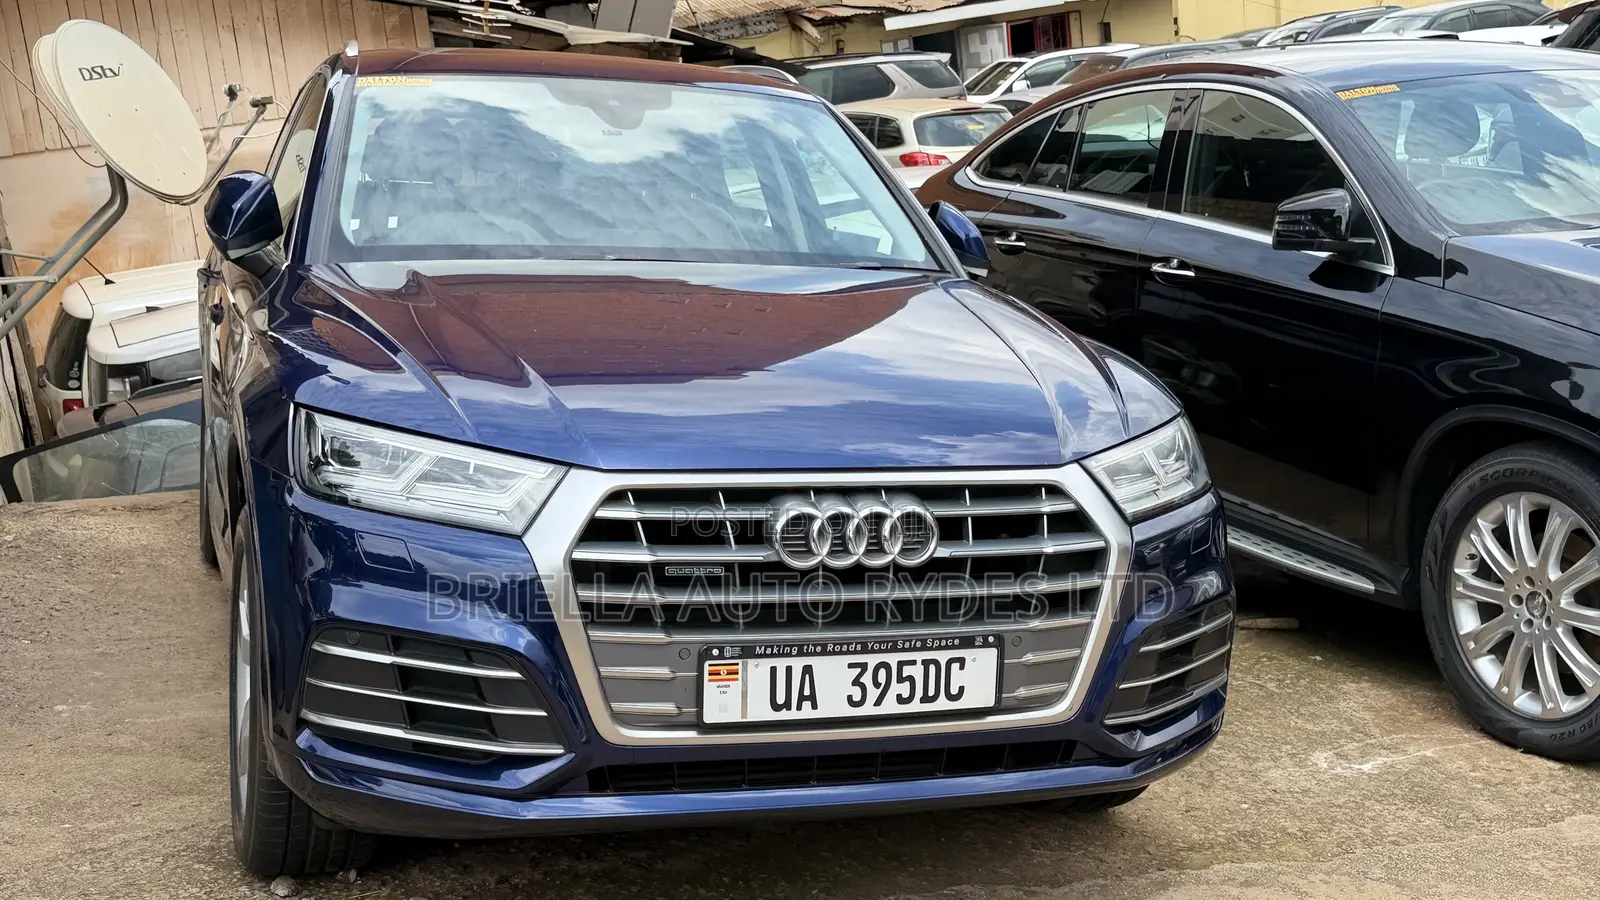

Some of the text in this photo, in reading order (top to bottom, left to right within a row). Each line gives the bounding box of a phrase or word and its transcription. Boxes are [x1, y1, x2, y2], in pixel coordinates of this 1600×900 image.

[78, 65, 121, 81] DStv
[668, 567, 722, 575] quattro
[755, 638, 960, 655] Making the Roads Your Safe Space
[769, 656, 966, 712] UA 395DC
